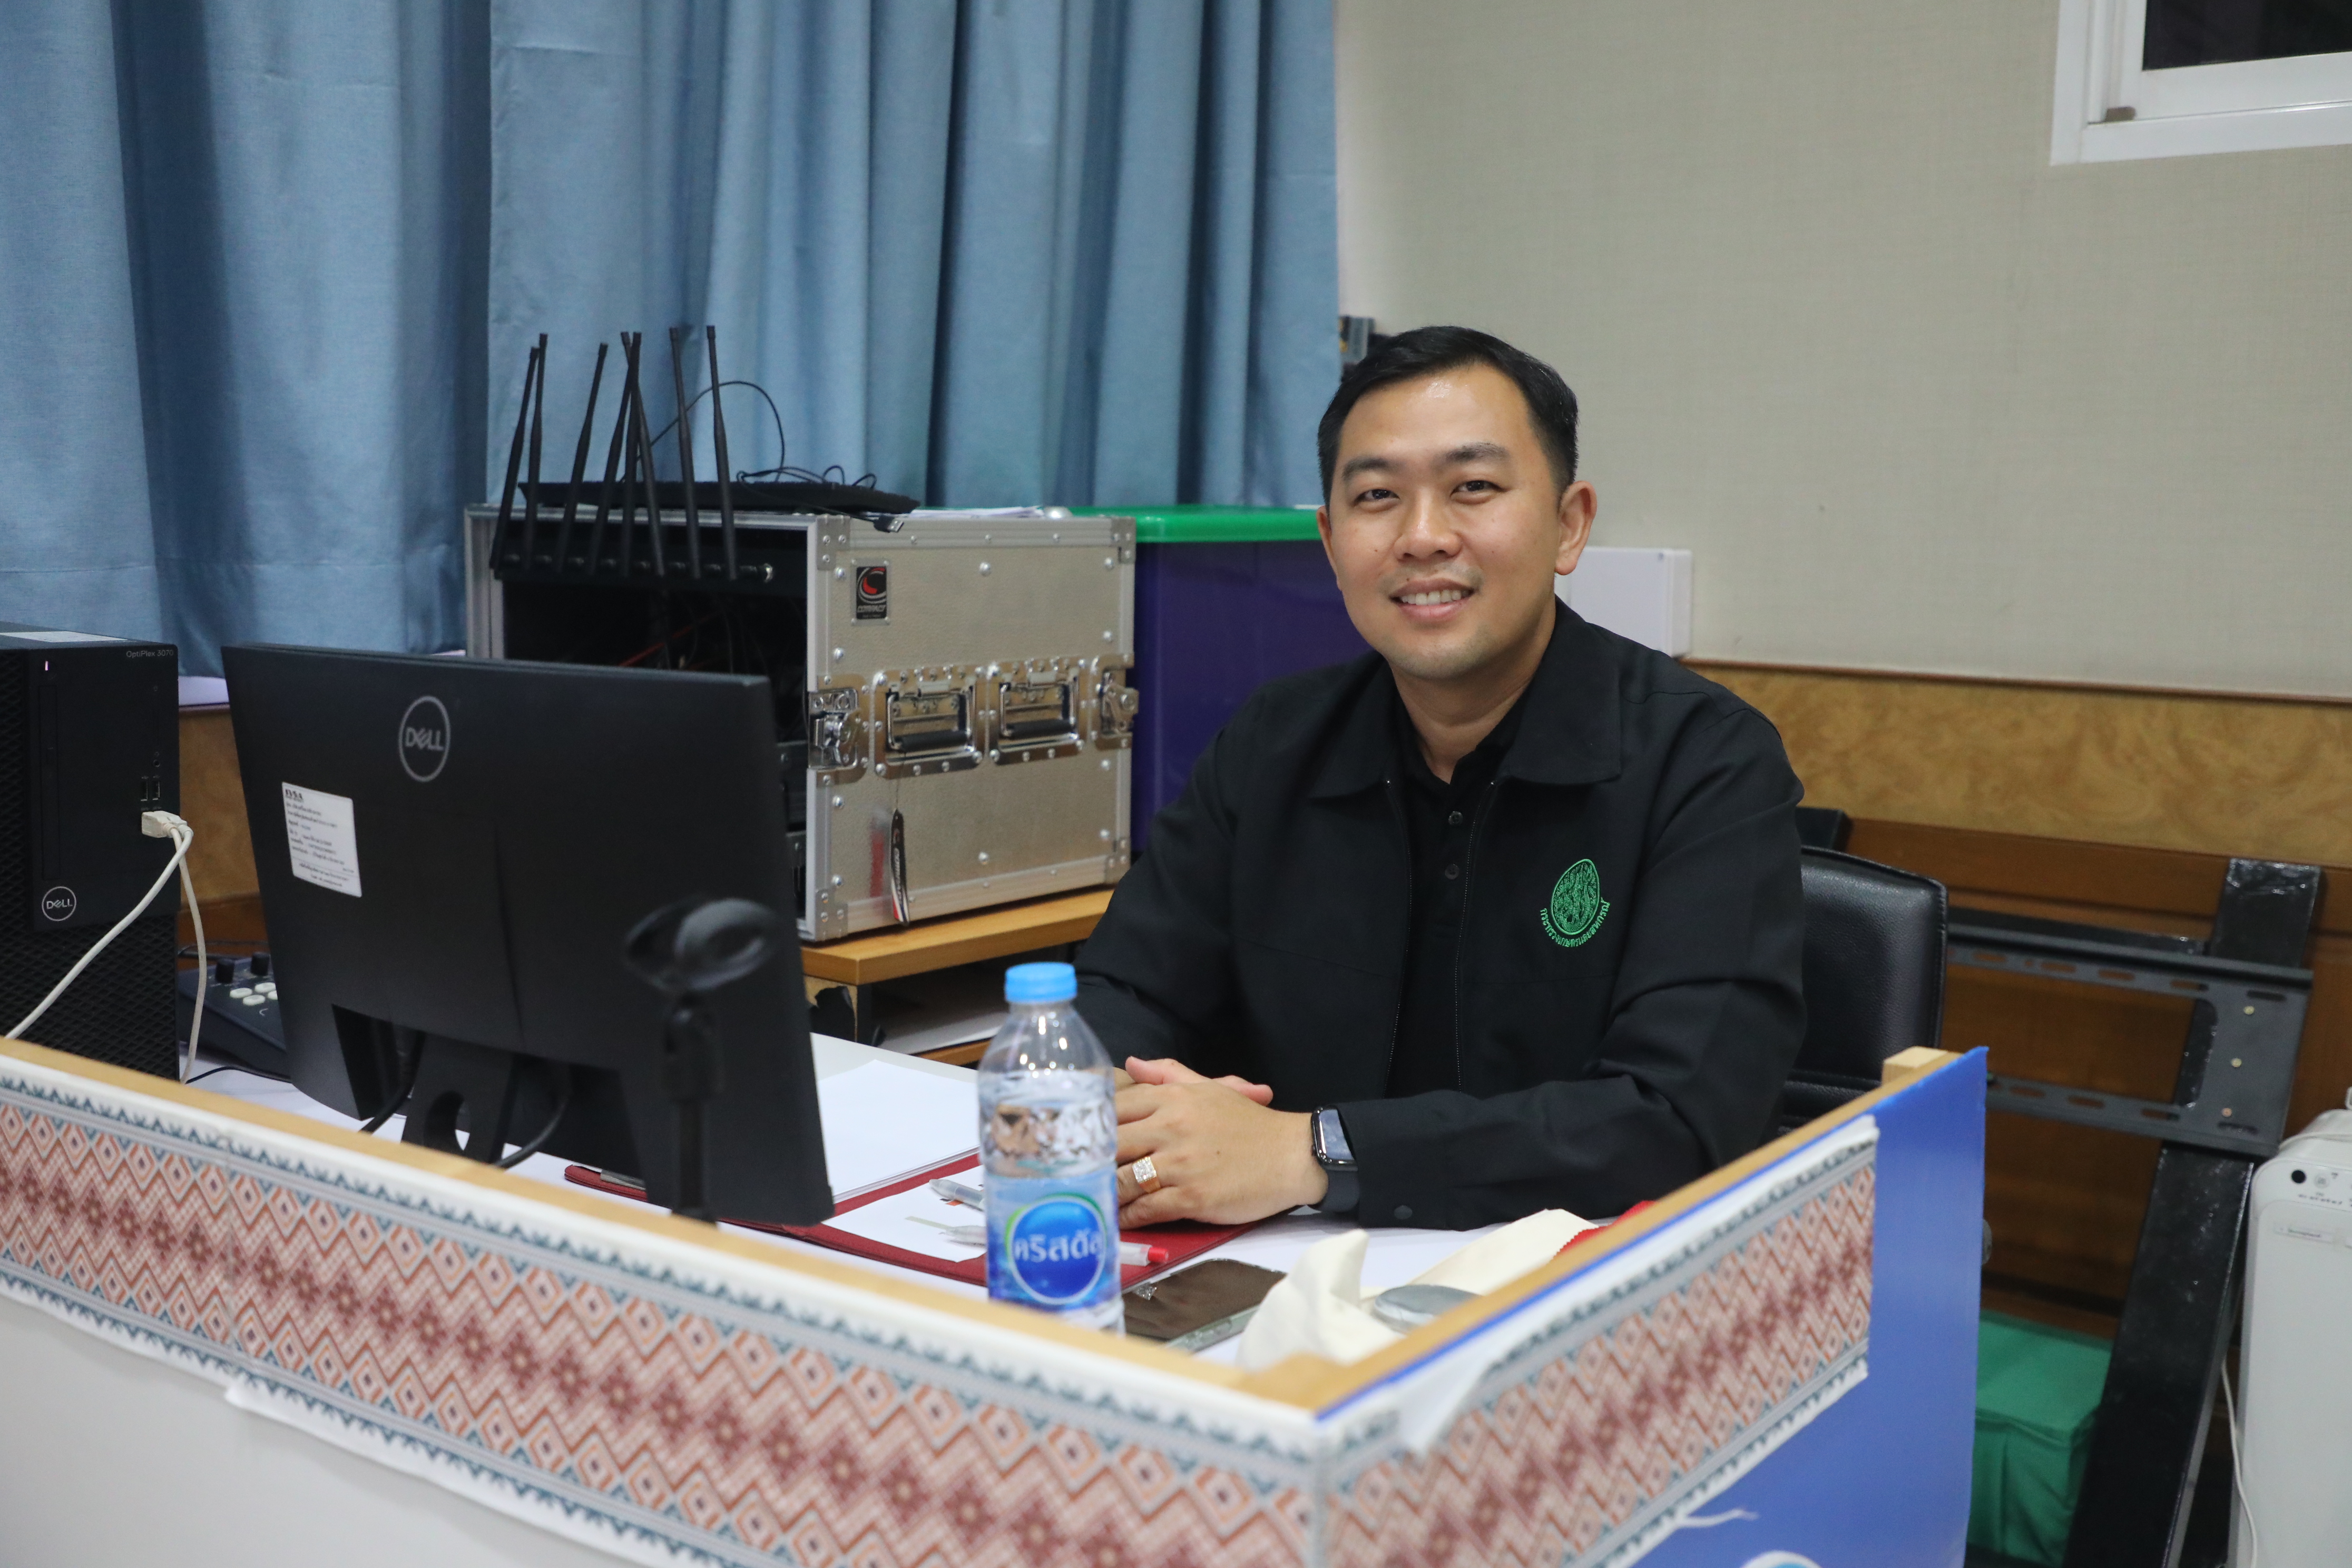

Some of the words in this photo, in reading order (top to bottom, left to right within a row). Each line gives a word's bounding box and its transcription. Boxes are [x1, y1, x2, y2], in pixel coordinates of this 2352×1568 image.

[126, 650, 155, 659] OptiPlex
[405, 727, 445, 751] DELL
[46, 898, 73, 909] DELL
